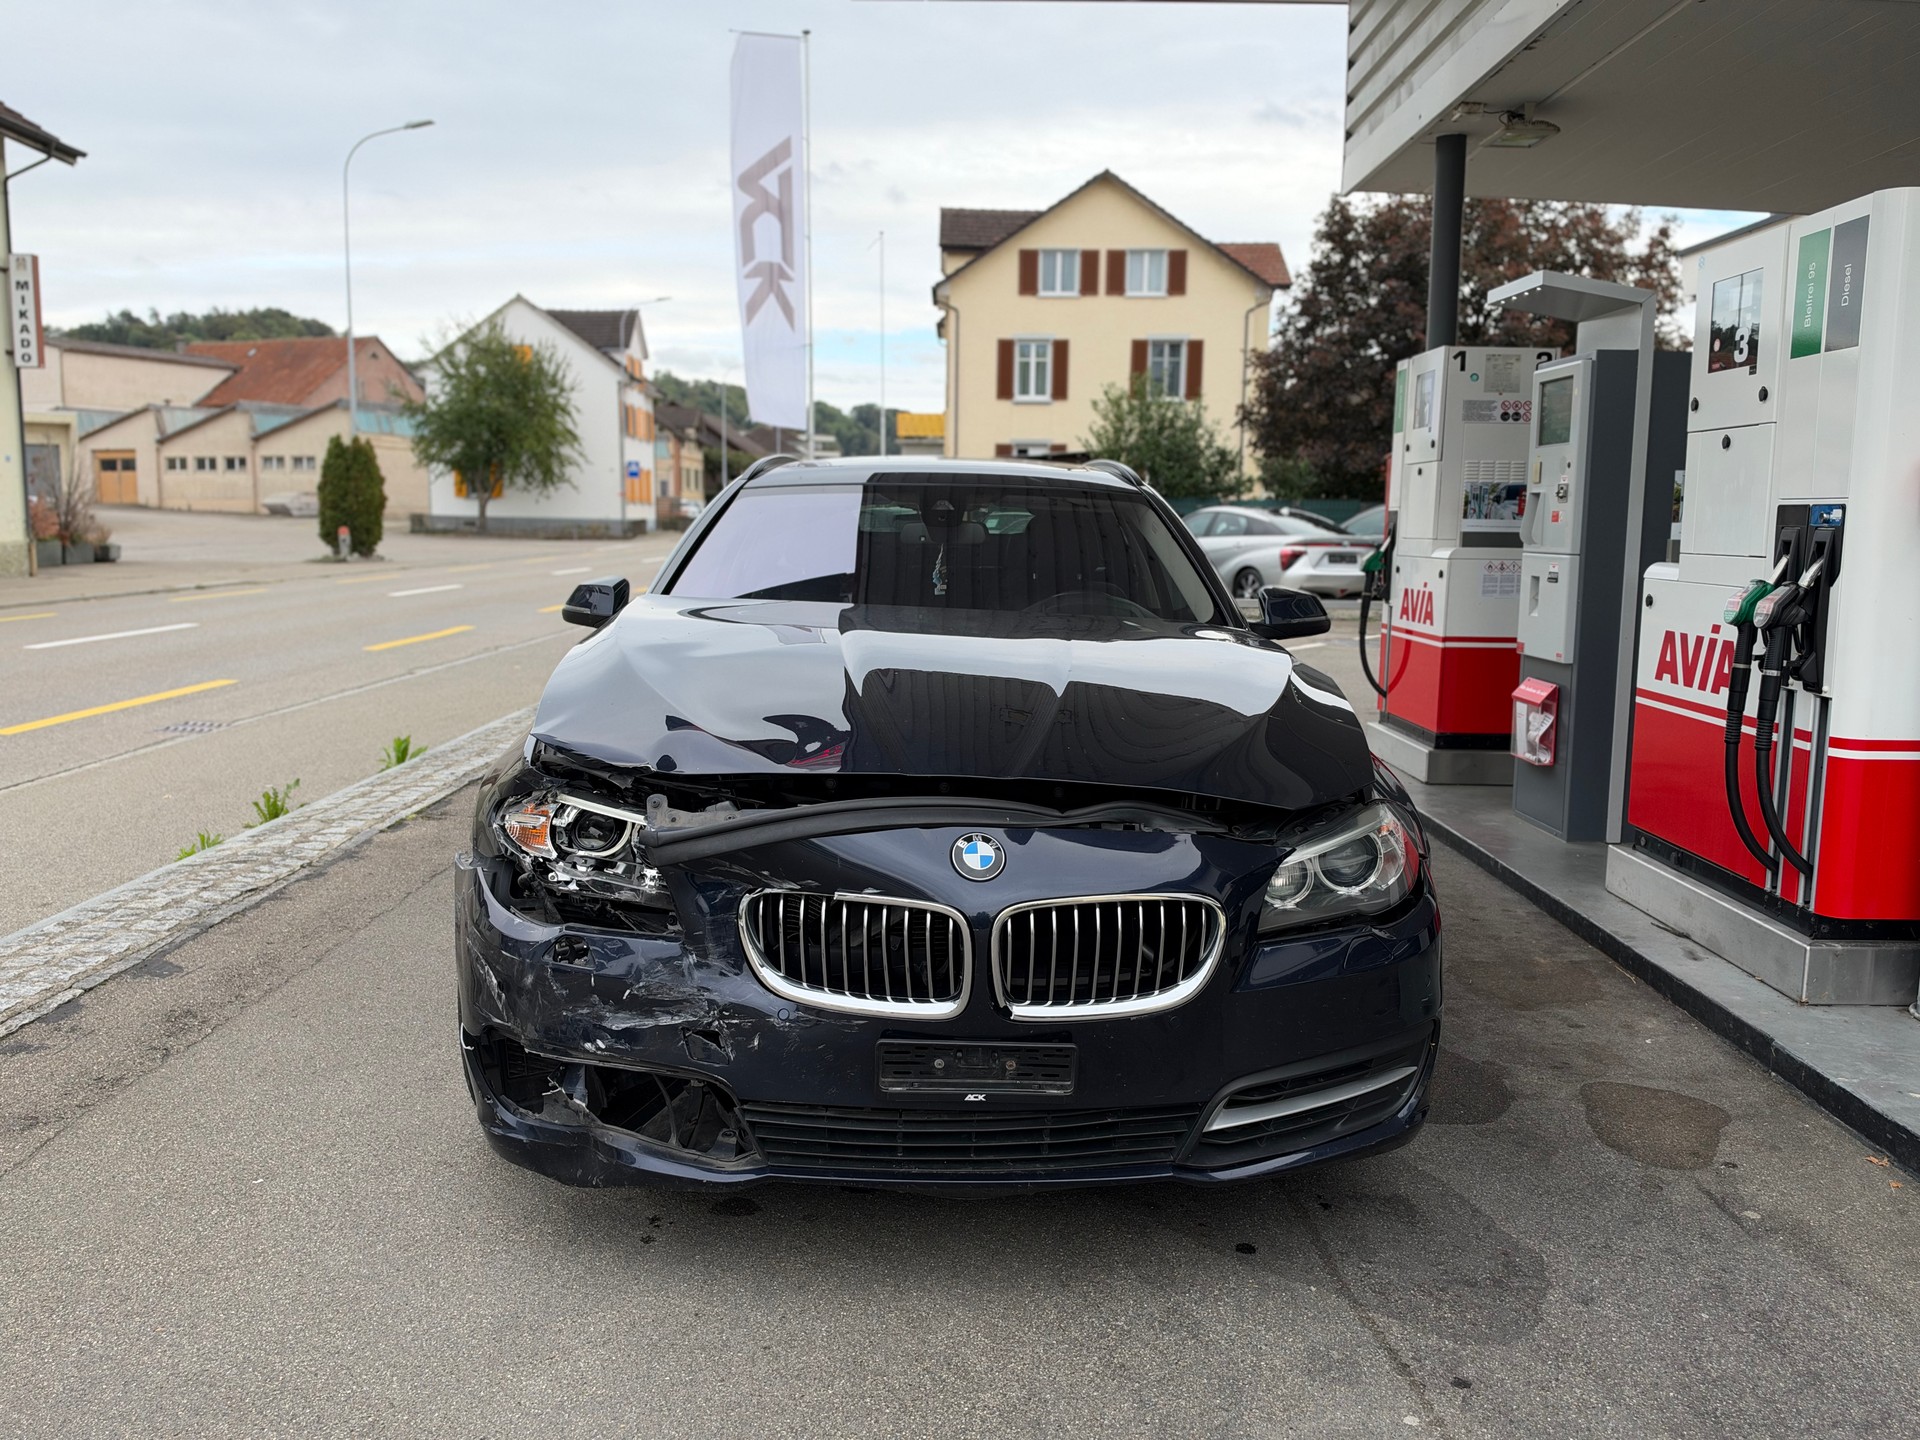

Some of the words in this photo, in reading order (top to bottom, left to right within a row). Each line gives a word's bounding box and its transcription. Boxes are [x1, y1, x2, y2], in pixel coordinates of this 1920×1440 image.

[1807, 262, 1817, 279] 95
[1841, 263, 1852, 307] Diesel
[15, 280, 32, 363] MIKADO
[1803, 282, 1815, 328] Bleifrei
[1452, 350, 1467, 372] 1
[1733, 327, 1750, 363] 3
[1400, 581, 1434, 627] AVIA
[957, 834, 999, 849] BMW
